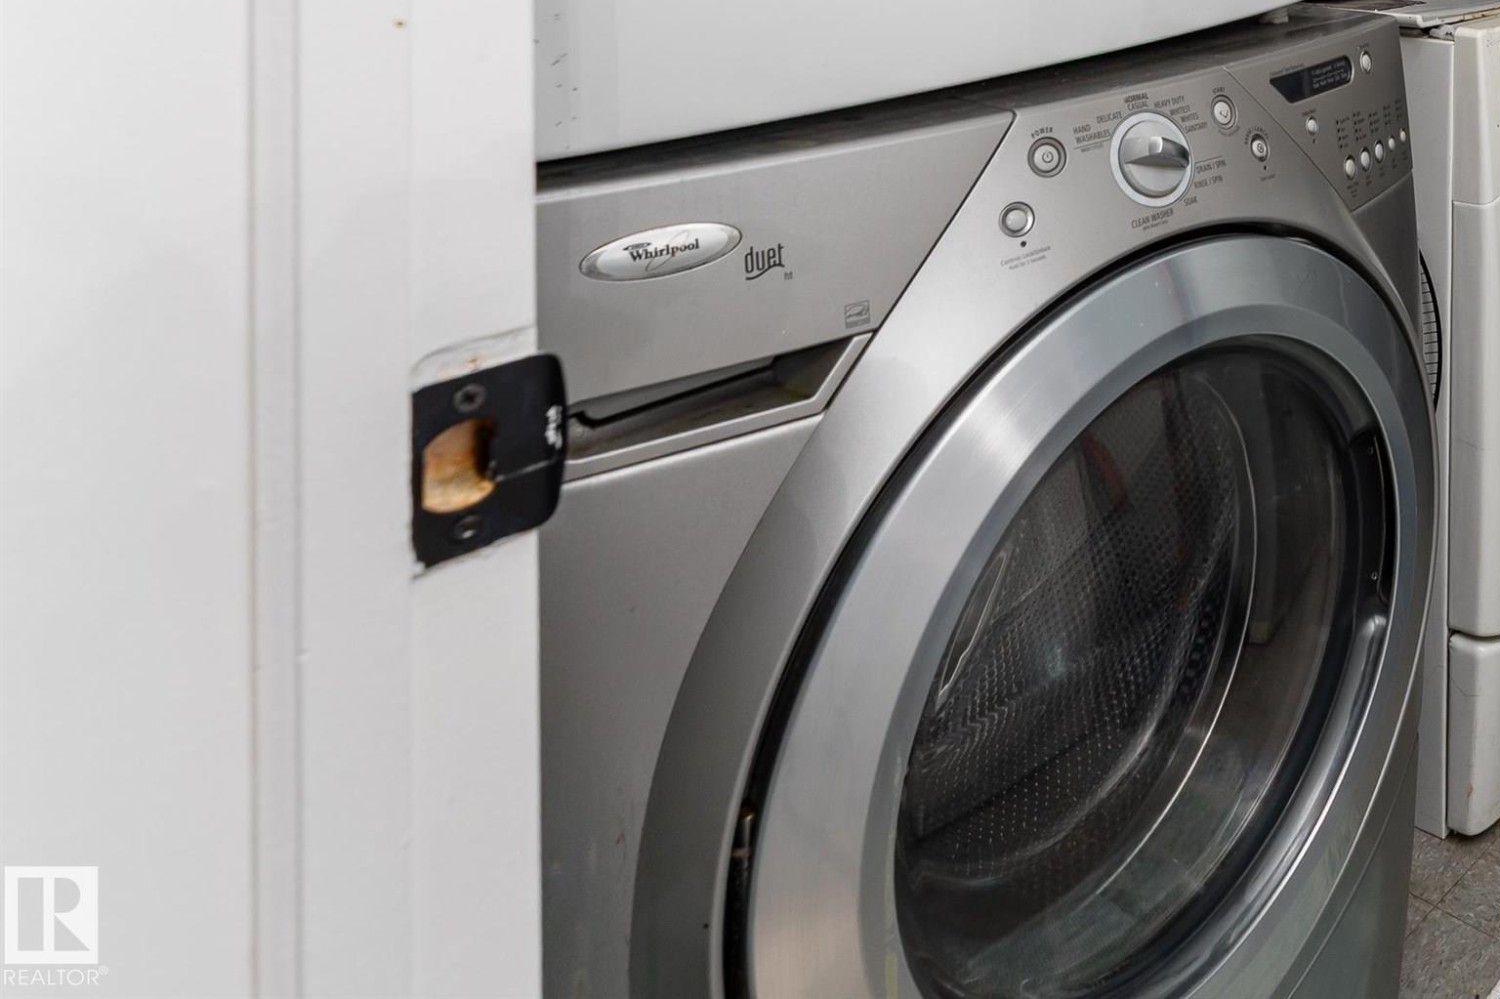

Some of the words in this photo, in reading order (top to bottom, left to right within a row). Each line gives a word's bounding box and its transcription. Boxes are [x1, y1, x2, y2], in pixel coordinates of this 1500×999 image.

[1072, 124, 1092, 135] HAND
[629, 238, 700, 262] Whirlpool
[744, 243, 785, 280] duet
